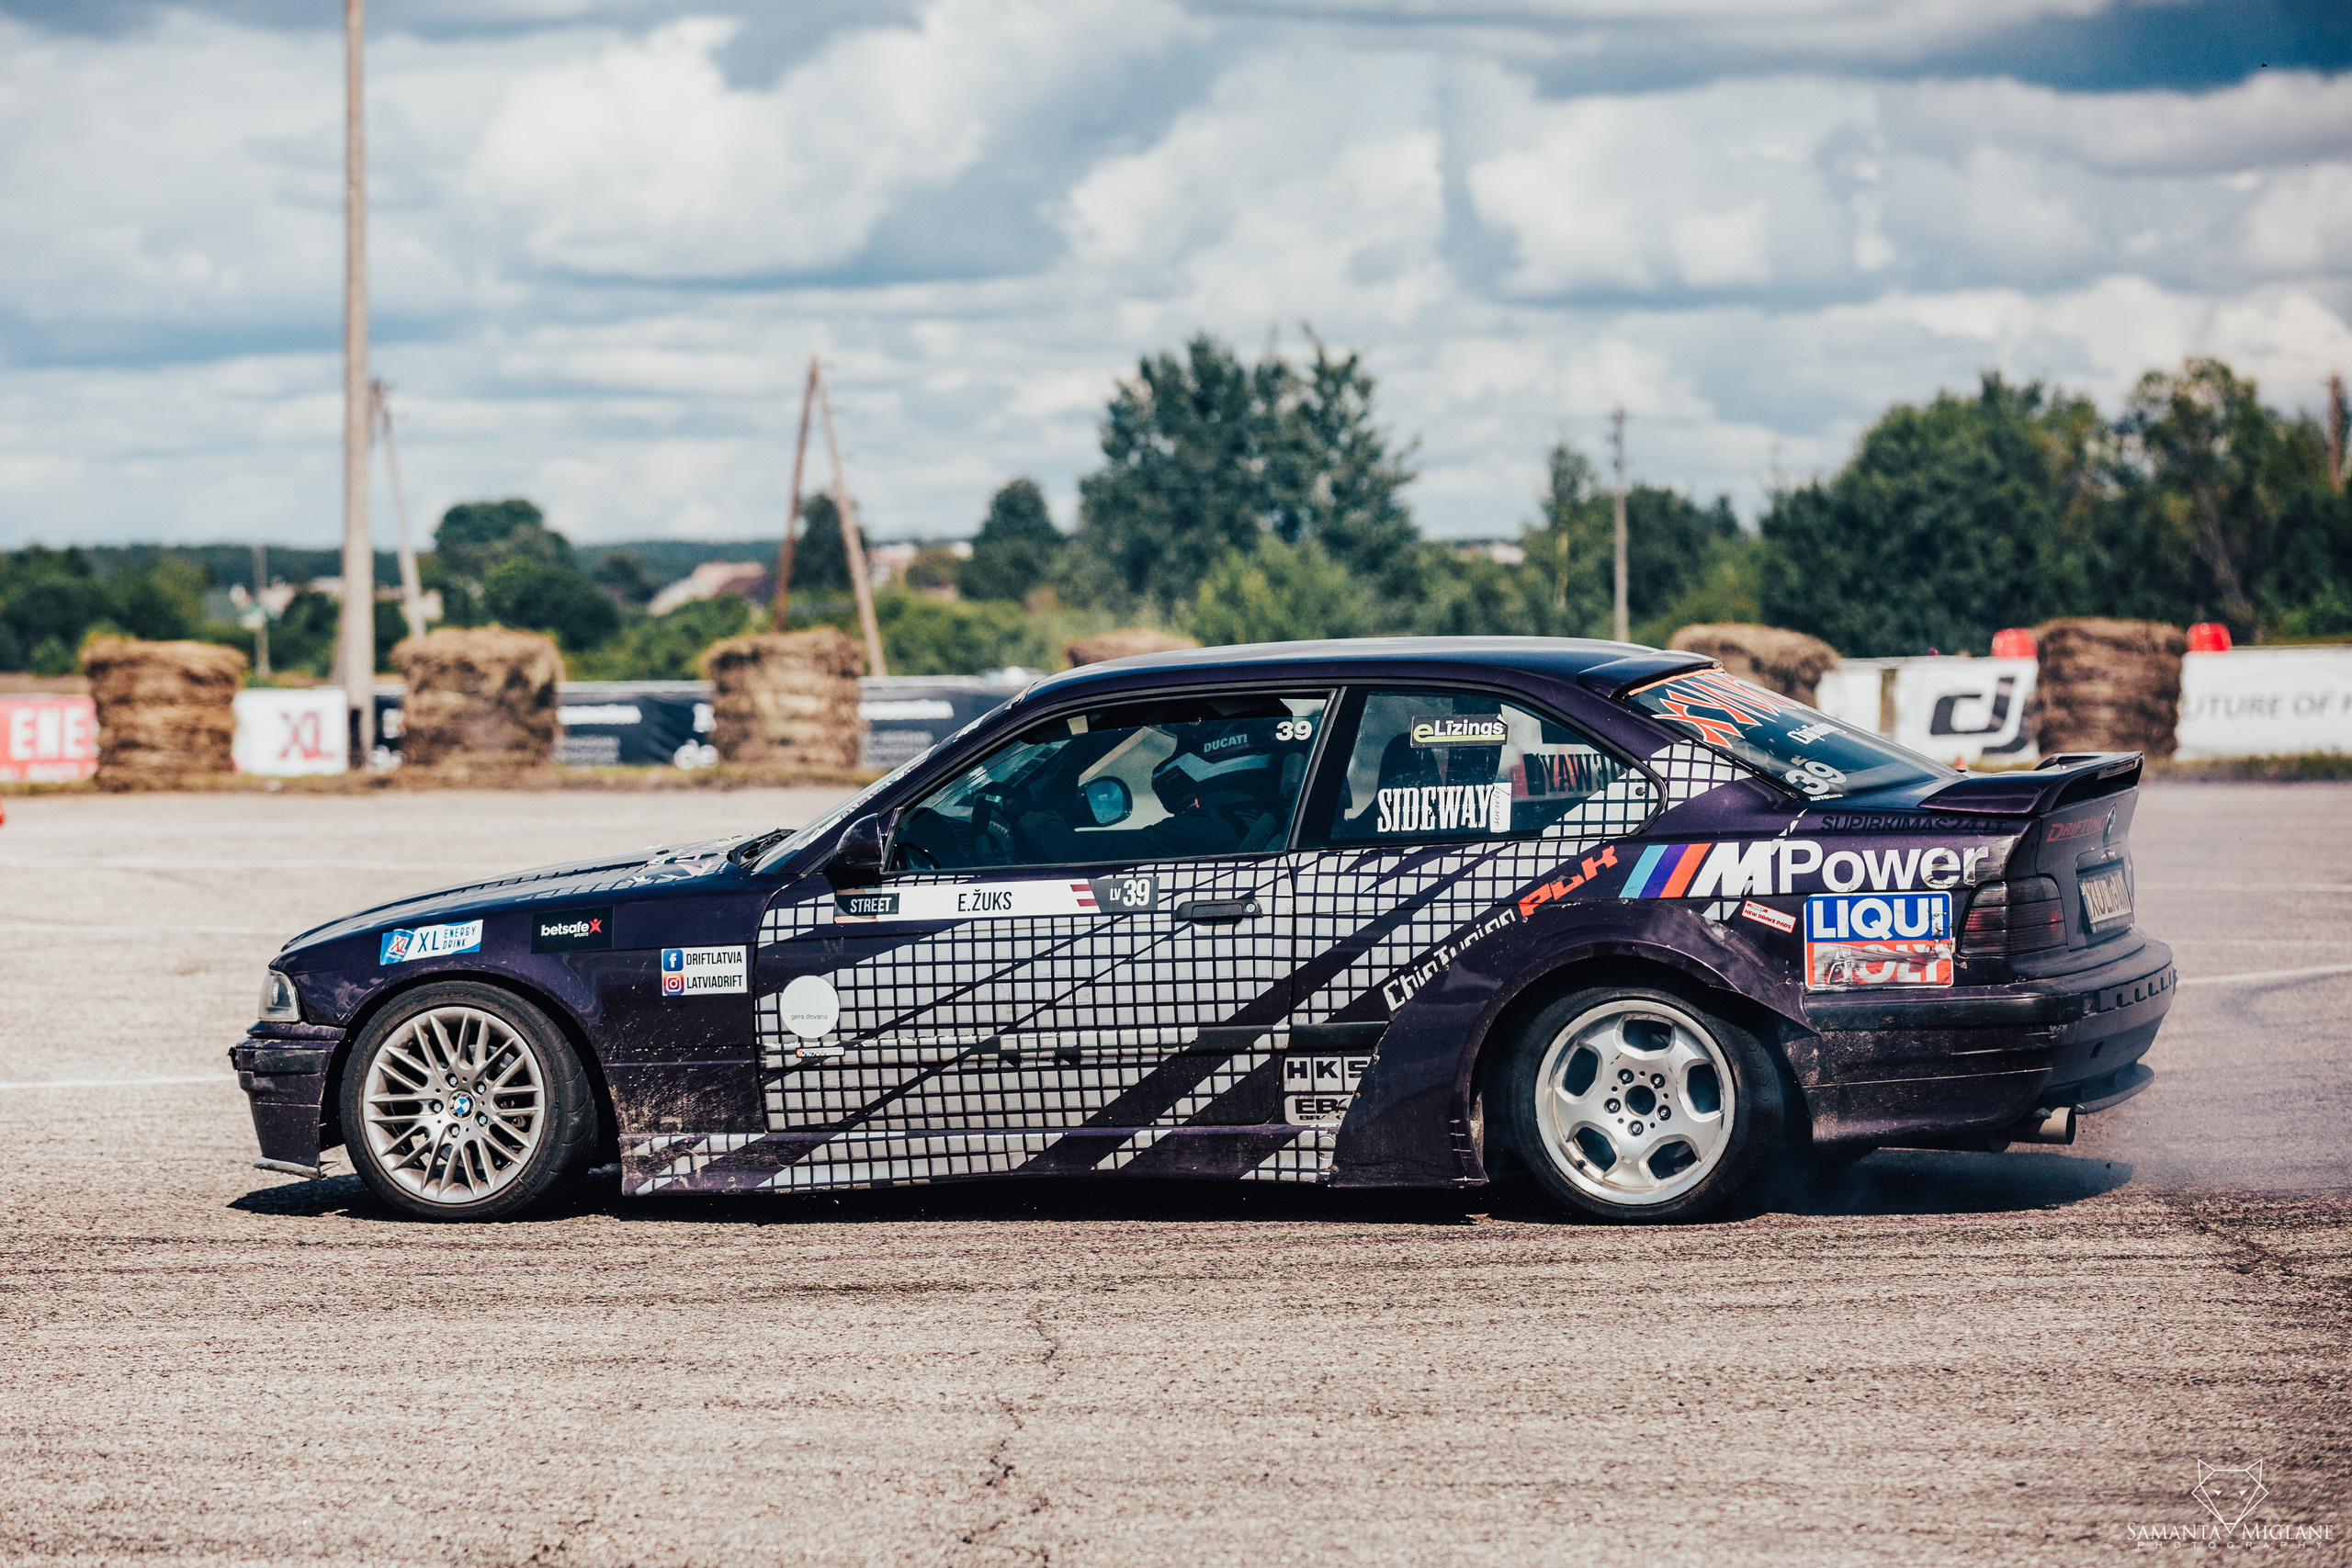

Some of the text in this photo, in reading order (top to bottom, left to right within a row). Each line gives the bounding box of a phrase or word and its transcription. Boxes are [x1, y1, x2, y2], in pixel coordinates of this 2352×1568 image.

[279, 711, 335, 761] XL
[1275, 720, 1313, 741] 39
[1204, 734, 1248, 753] DUCATI
[1785, 761, 1847, 795] 39
[1377, 784, 1494, 832] SIDEWAY
[958, 888, 1012, 912] E.ŽUKS
[1110, 879, 1150, 907] LV 39
[850, 897, 892, 913] STREET
[540, 920, 590, 937] betsafe
[1758, 914, 1776, 923] BRAKE
[1777, 920, 1792, 930] PADS
[1813, 897, 1943, 941] LIQUI
[390, 936, 407, 953] XL
[417, 926, 477, 953] XL ENERGY
[442, 938, 467, 950] DRINK
[686, 951, 742, 965] DRIFTLATVIA
[686, 975, 742, 989] LATVIADRIFT
